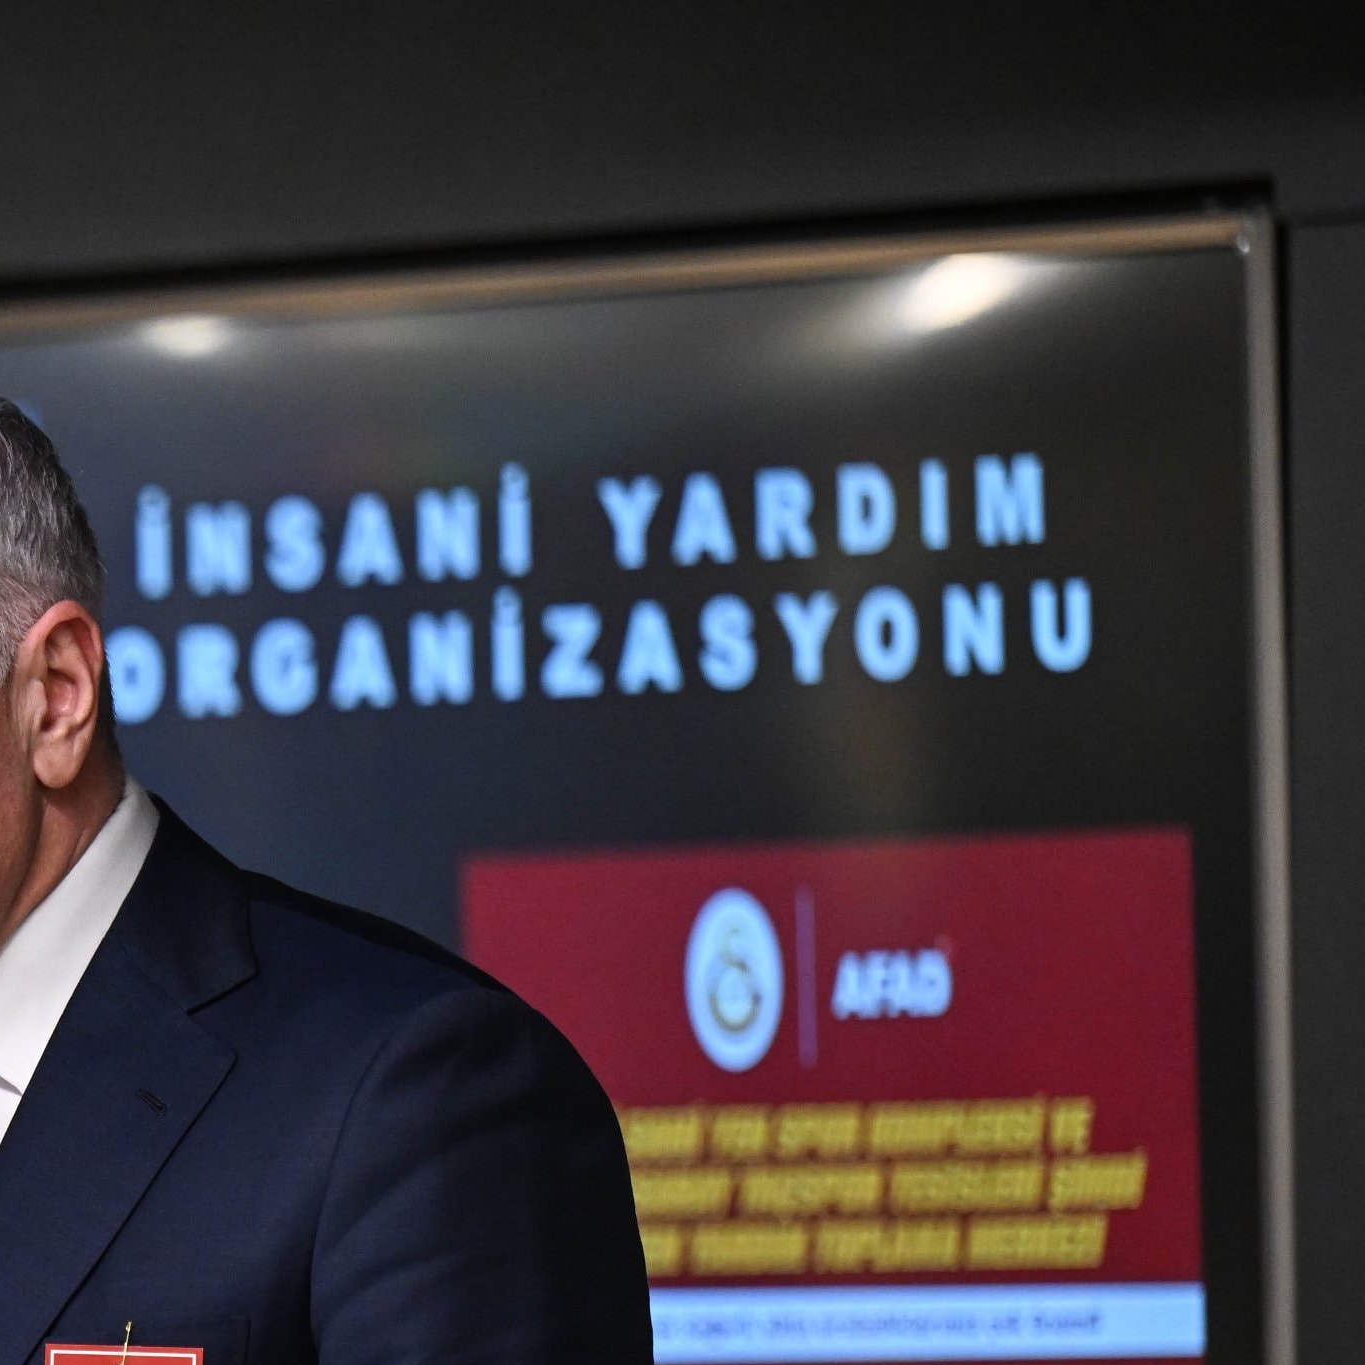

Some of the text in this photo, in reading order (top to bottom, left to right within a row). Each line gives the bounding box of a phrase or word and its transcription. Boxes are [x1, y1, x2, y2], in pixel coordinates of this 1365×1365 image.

[135, 452, 1046, 598] İNSANİ YARDIM
[105, 578, 1093, 723] ORGANİZASYONU
